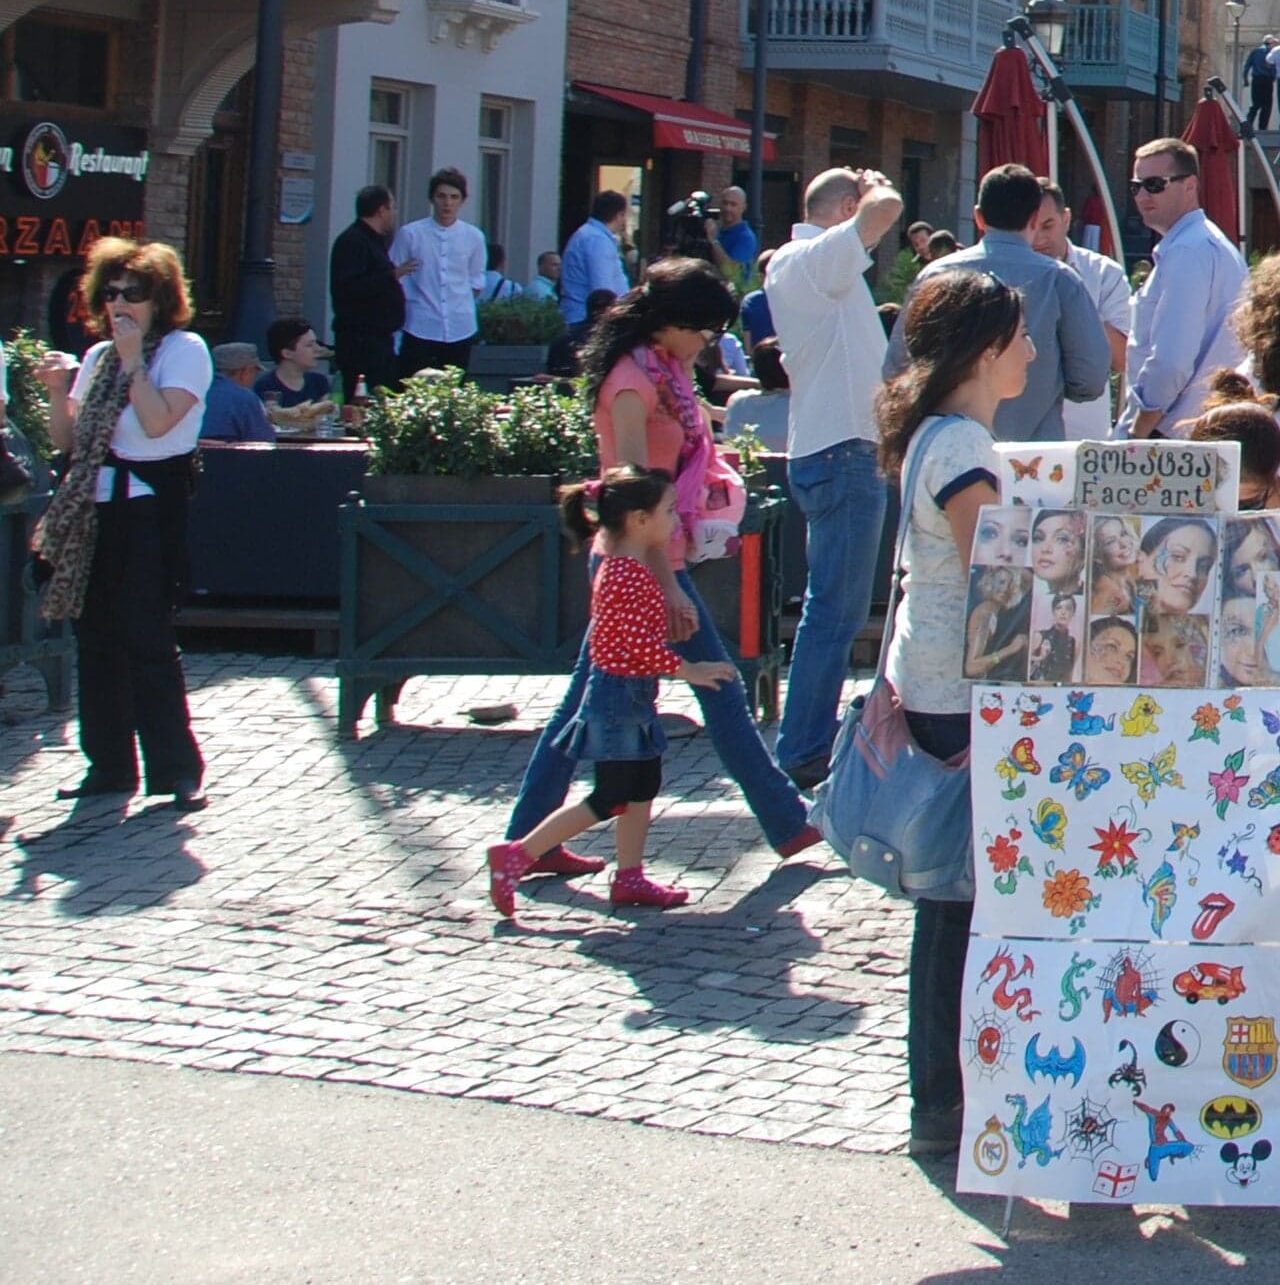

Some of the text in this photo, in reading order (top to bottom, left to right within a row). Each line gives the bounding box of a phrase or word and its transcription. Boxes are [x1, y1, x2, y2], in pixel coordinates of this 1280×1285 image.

[68, 142, 149, 181] Restaurant
[1083, 448, 1212, 477] მოხატვა
[1081, 481, 1205, 507] Face art
